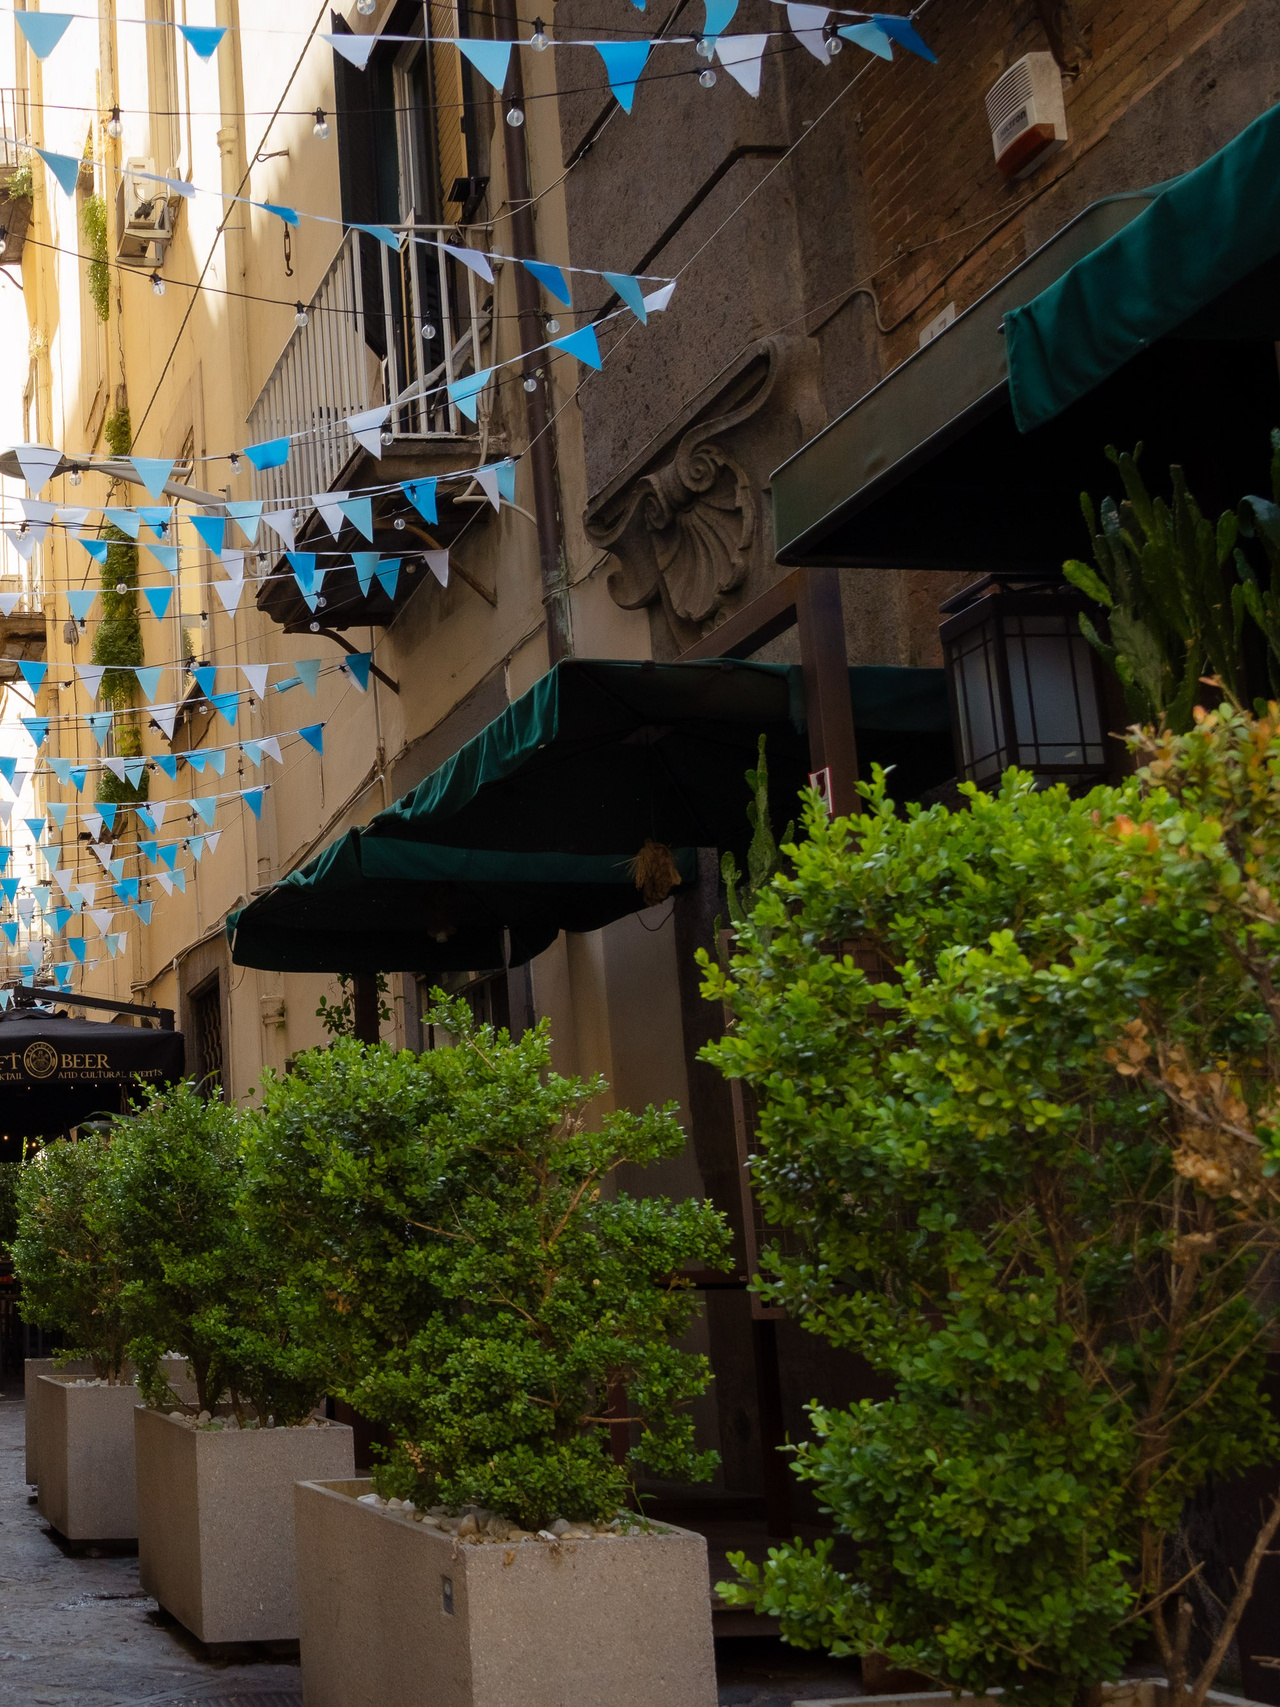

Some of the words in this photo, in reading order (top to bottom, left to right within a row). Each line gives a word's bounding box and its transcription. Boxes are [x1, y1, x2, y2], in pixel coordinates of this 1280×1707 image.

[60, 1053, 111, 1069] BEER
[58, 1071, 78, 1079] AND
[80, 1070, 127, 1079] CULTURAL
